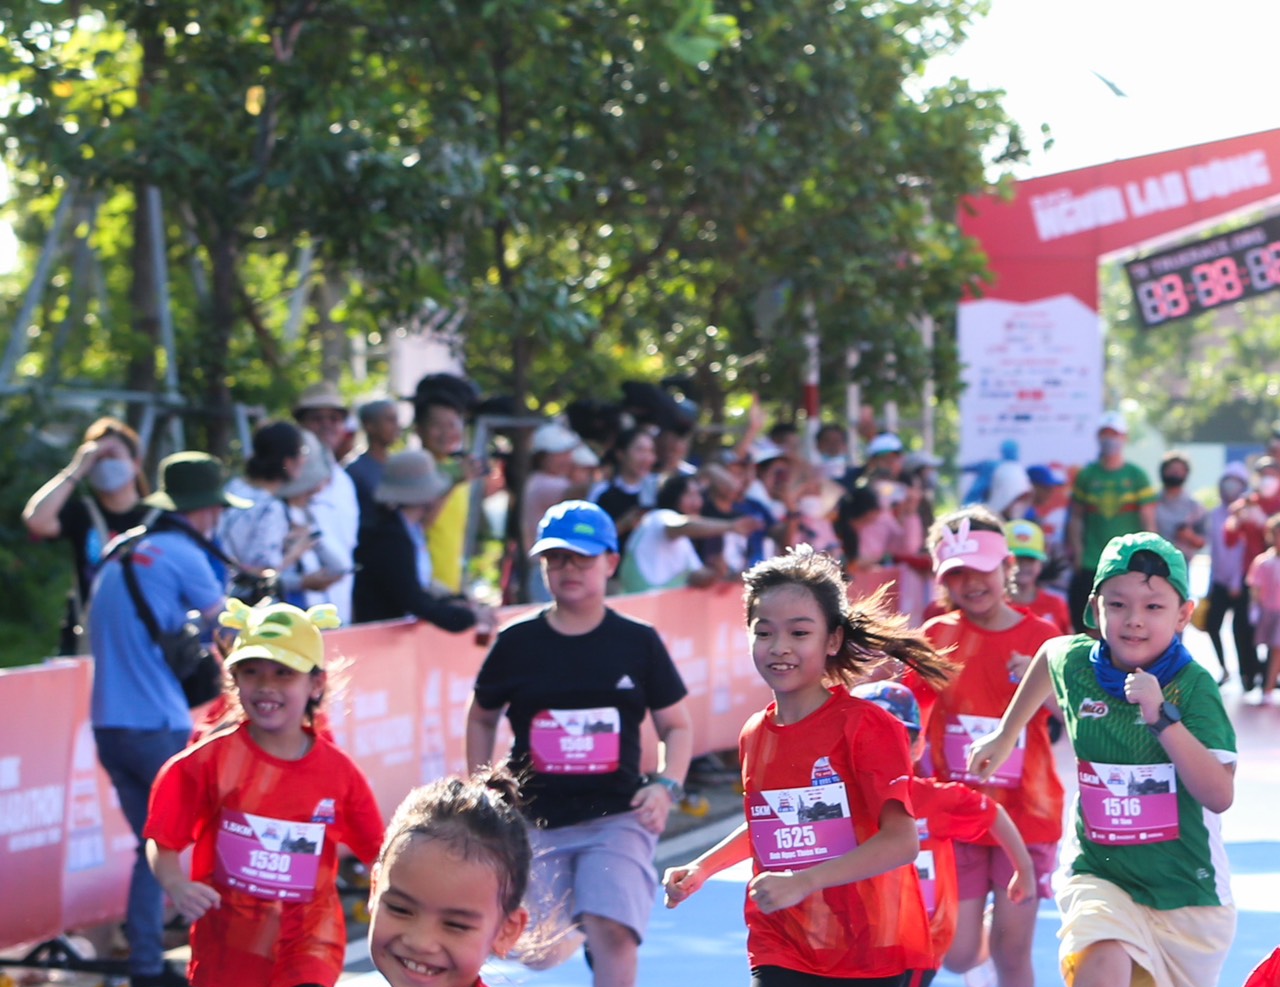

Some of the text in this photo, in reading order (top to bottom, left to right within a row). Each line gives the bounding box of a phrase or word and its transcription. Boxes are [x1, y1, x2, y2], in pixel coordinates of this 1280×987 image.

[1126, 171, 1188, 218] LAO
[1102, 798, 1141, 817] 1516
[773, 825, 817, 849] 1525
[249, 849, 291, 873] 1530
